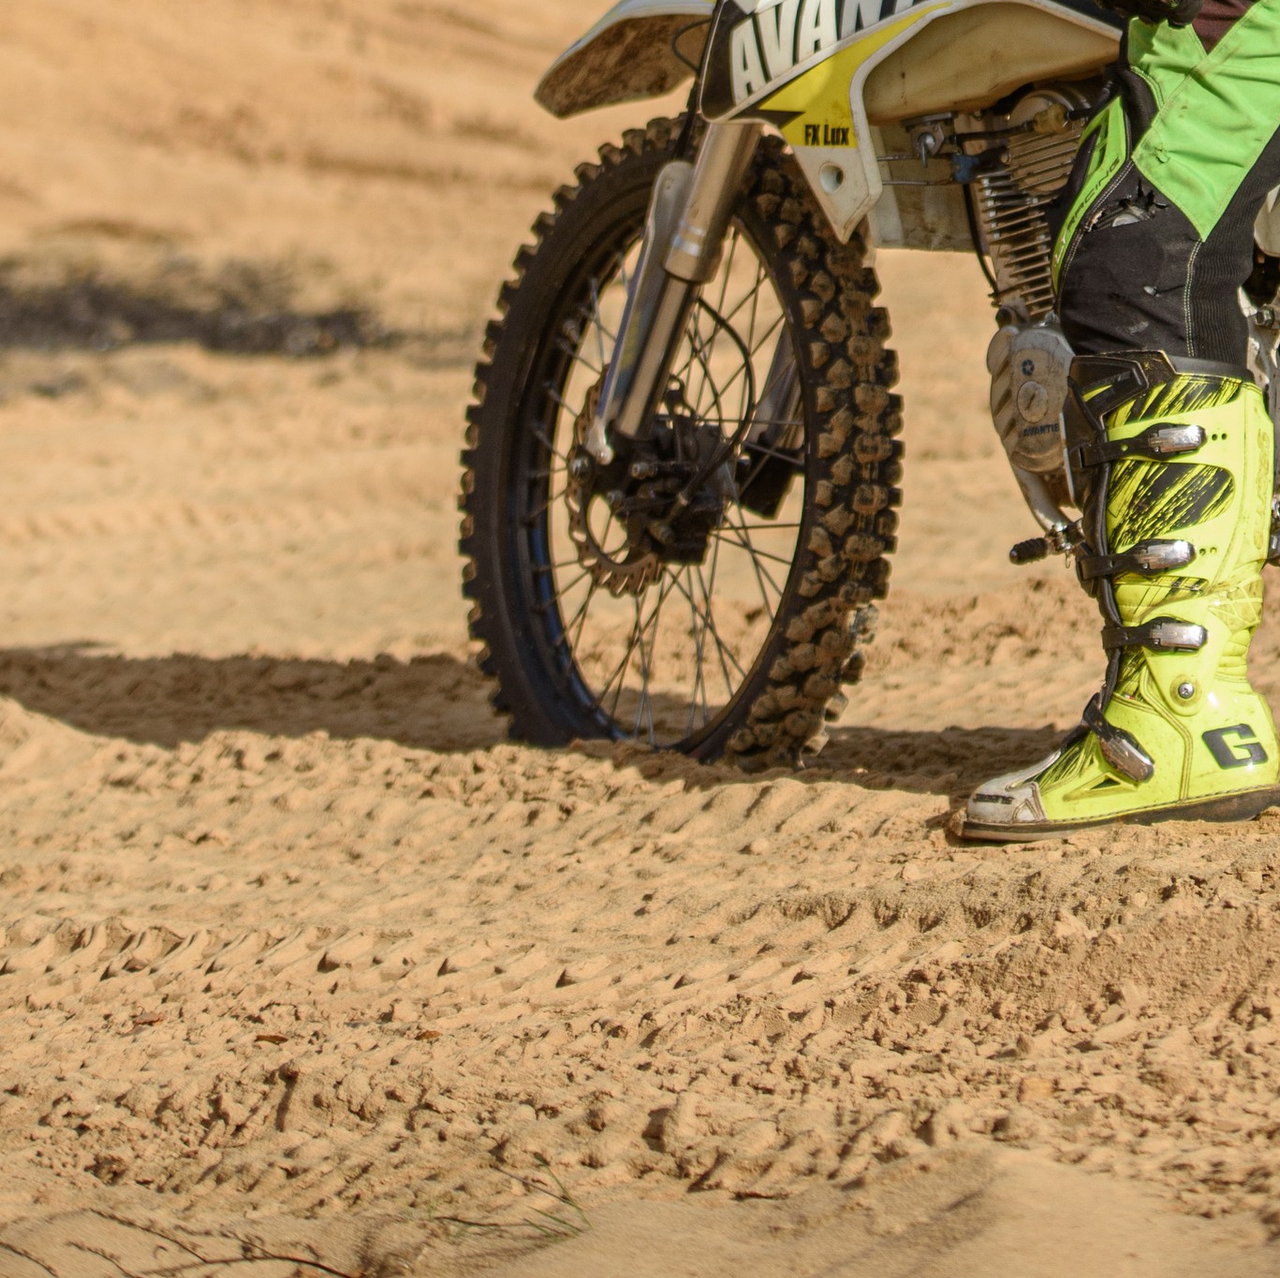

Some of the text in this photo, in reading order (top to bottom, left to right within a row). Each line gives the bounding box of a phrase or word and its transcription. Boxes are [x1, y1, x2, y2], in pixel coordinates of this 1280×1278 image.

[805, 124, 820, 146] FX
[1067, 156, 1121, 231] RACING
[1201, 723, 1269, 770] G
